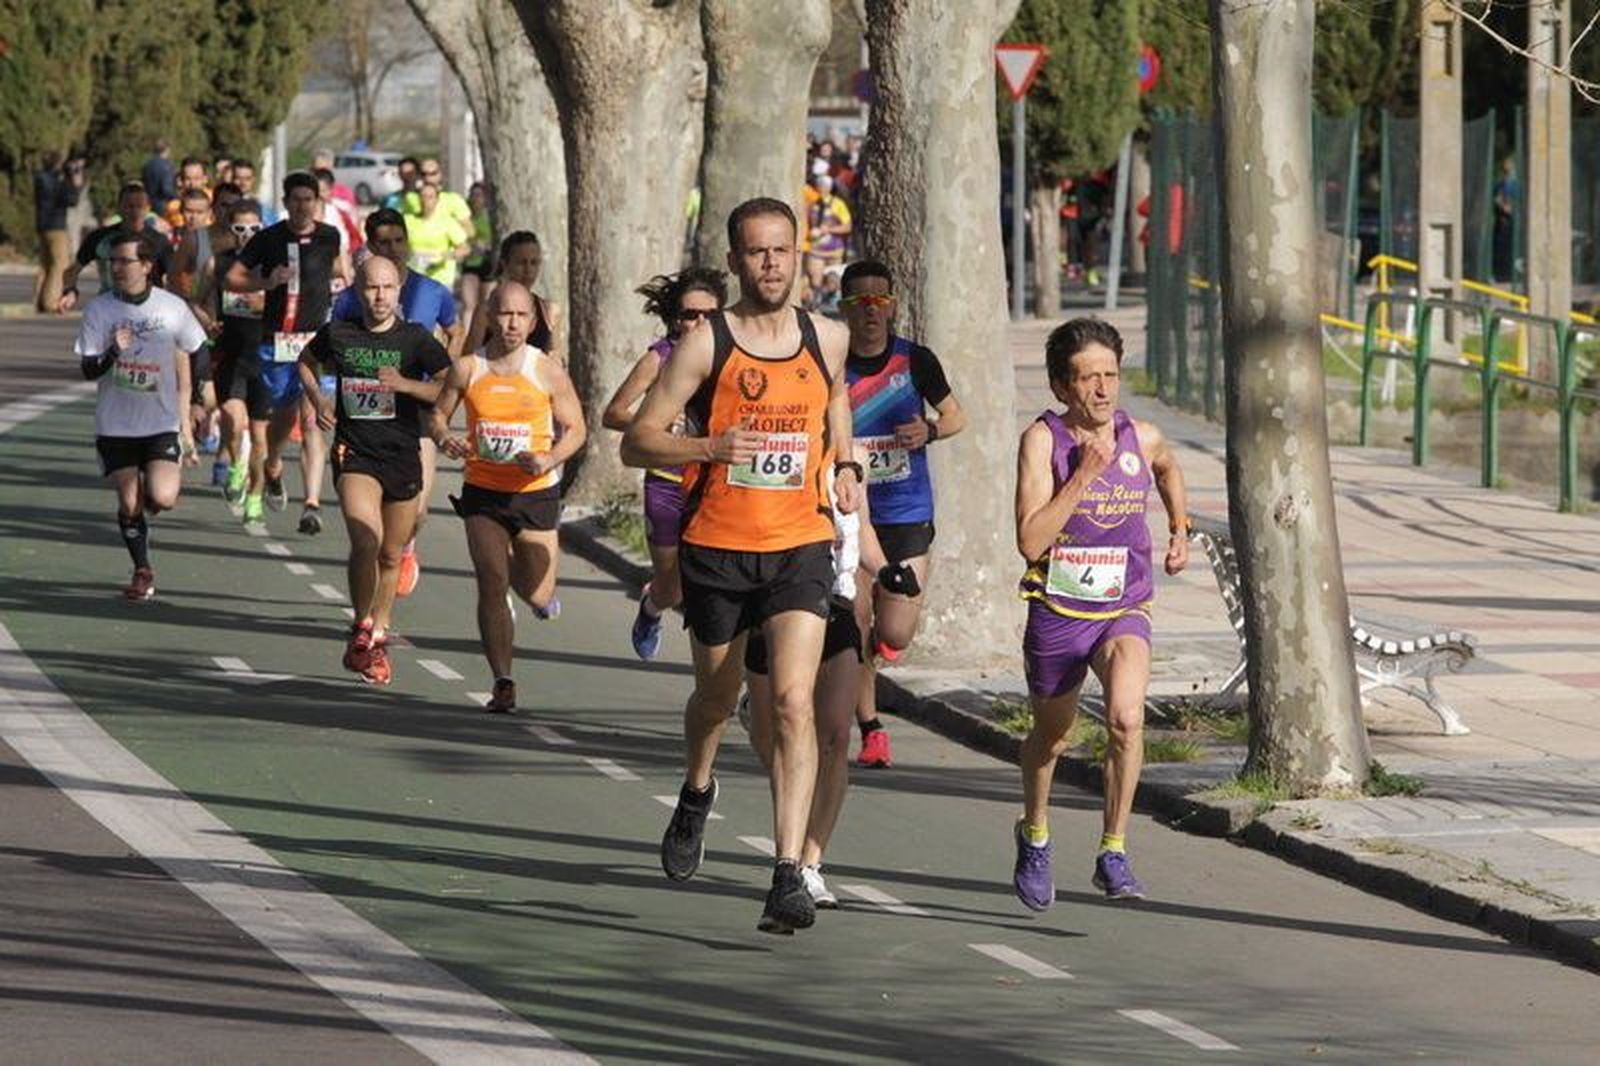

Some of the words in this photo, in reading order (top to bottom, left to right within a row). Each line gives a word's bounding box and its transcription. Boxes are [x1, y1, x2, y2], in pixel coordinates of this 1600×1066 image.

[128, 370, 147, 385] 18
[356, 393, 378, 409] 76
[491, 438, 513, 453] 77
[751, 453, 793, 475] 168
[869, 451, 890, 468] 21
[1079, 566, 1094, 586] 4
